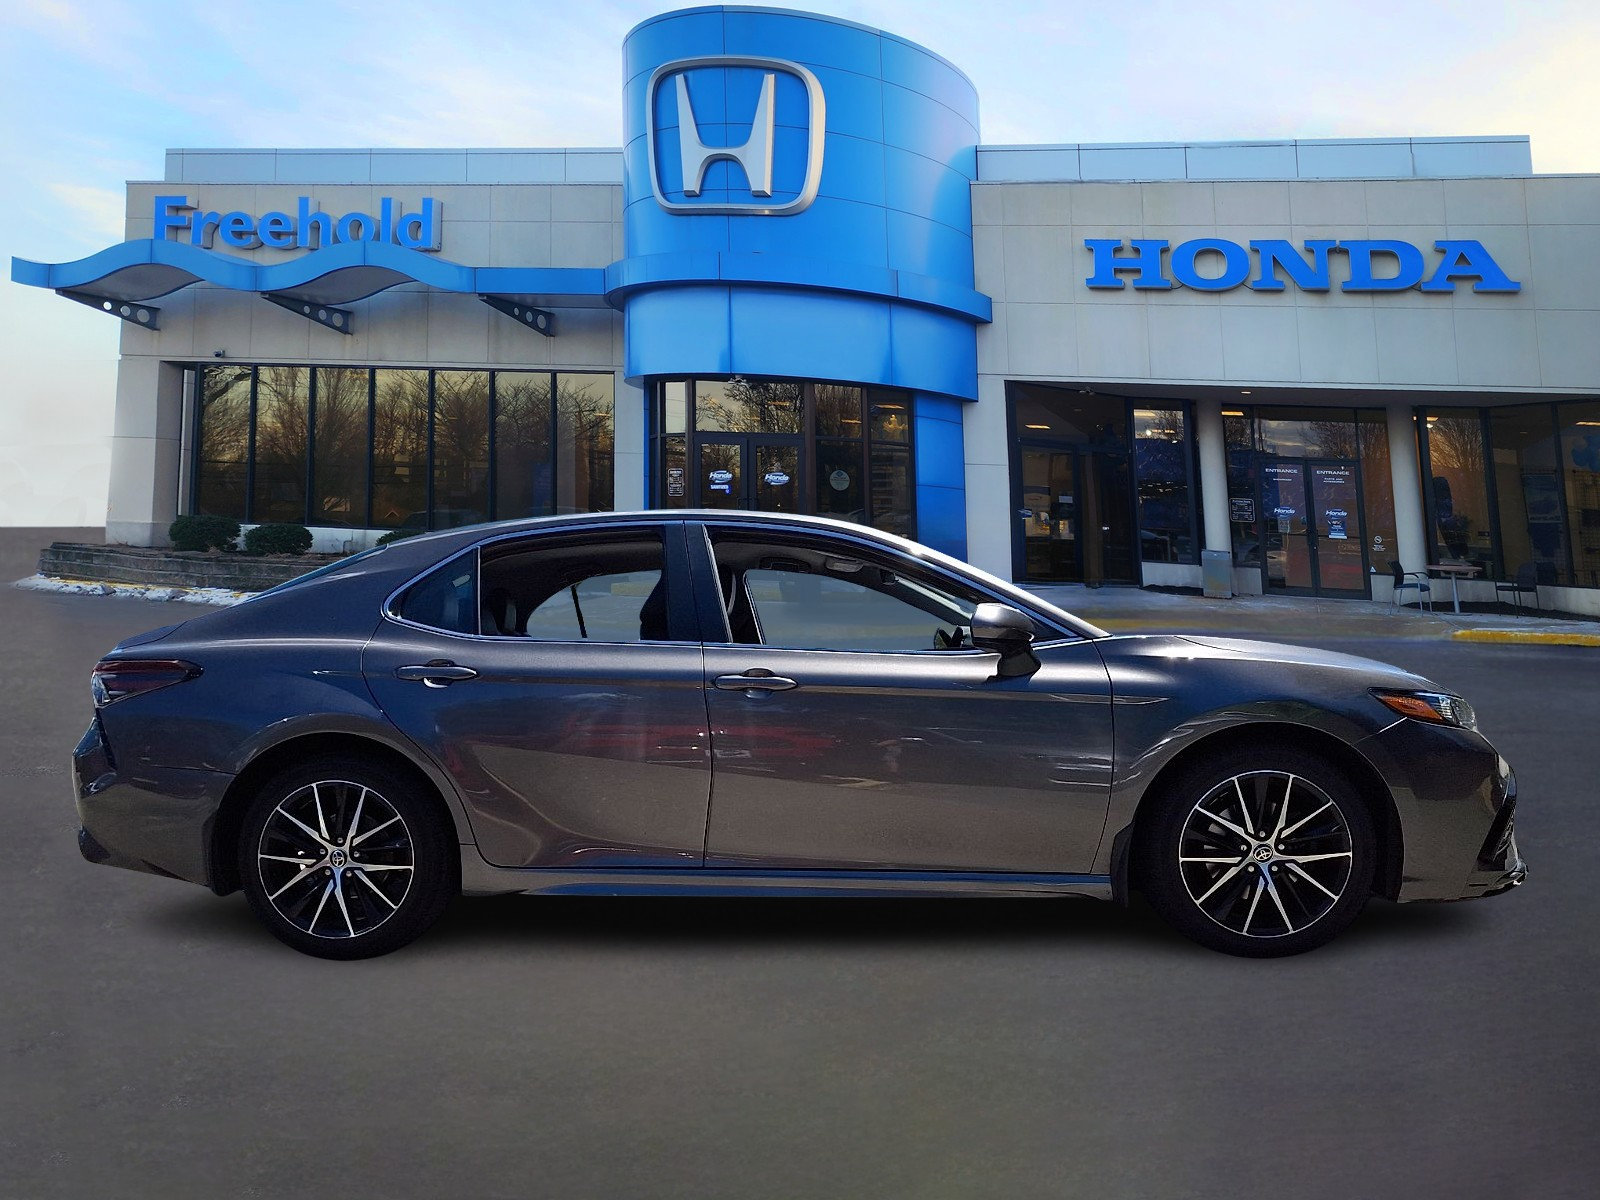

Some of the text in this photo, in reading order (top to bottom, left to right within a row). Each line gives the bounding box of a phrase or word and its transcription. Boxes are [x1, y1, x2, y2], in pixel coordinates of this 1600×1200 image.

[153, 195, 438, 250] Freehold
[1084, 238, 1521, 293] HONDA
[709, 471, 733, 480] Honda
[764, 473, 790, 481] Honda
